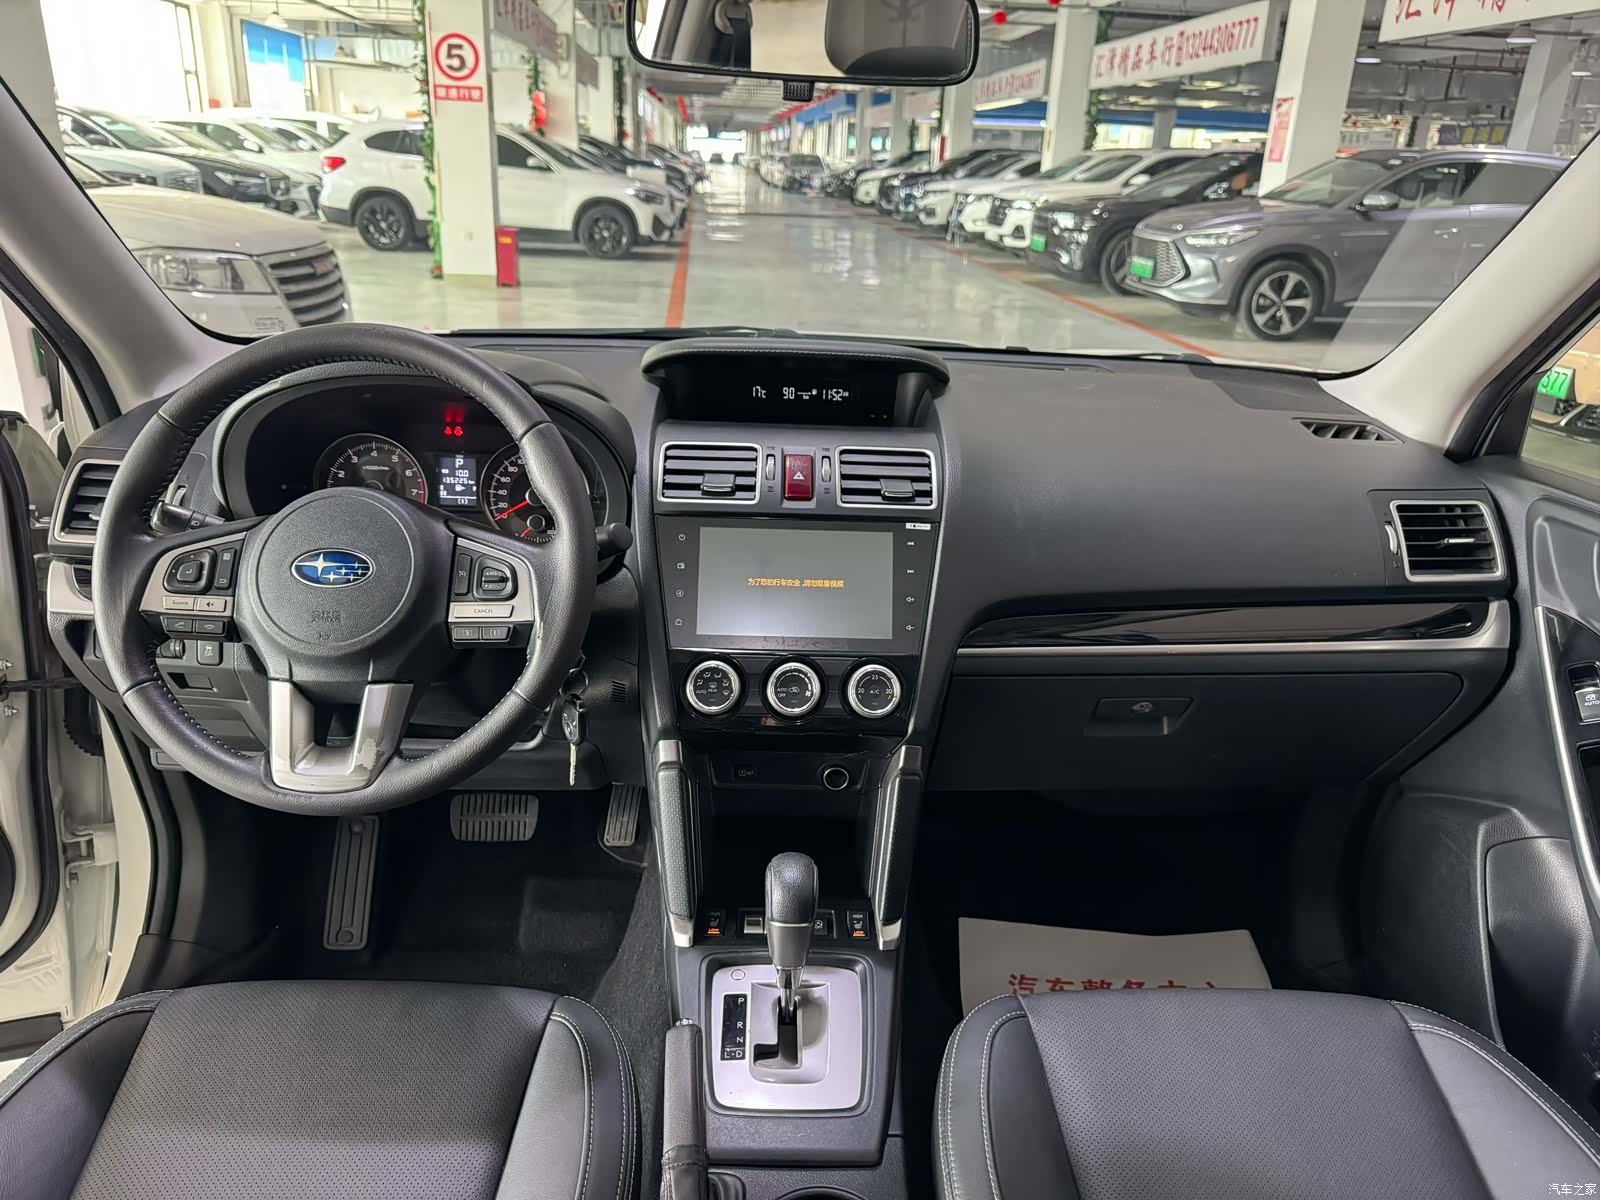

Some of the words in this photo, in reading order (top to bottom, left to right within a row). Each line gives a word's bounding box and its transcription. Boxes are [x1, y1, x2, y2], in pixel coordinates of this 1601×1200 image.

[446, 43, 466, 73] 5
[782, 386, 796, 400] 90
[351, 455, 358, 463] 3
[391, 455, 399, 463] 5
[455, 458, 464, 468] P
[337, 470, 345, 478] 2
[405, 469, 413, 477] 6
[411, 488, 418, 496] 7
[737, 997, 745, 1005] P
[736, 1021, 744, 1029] R
[736, 1036, 744, 1044] N
